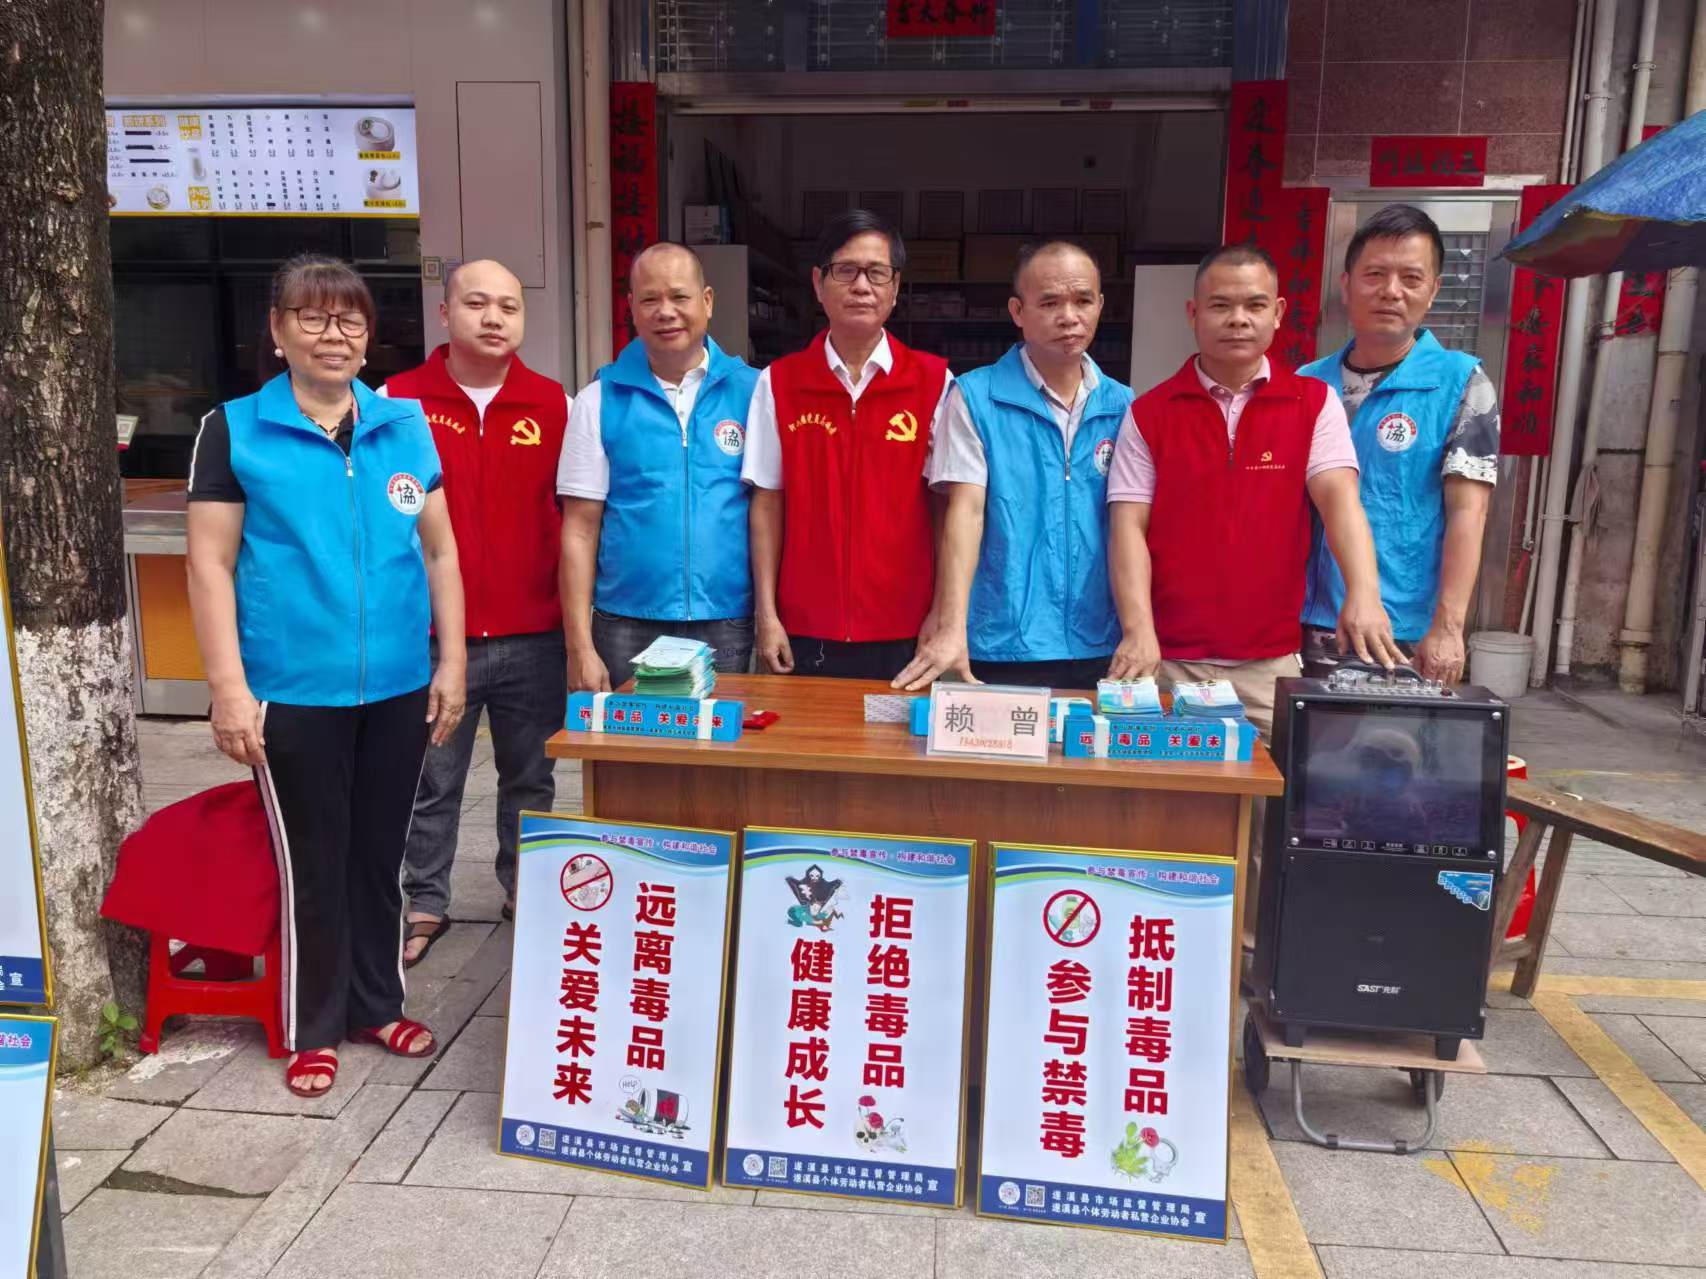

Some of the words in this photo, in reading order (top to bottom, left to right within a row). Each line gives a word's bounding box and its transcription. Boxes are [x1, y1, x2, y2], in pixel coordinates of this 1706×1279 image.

[552, 920, 602, 1106] 关爱未来
[626, 881, 677, 1071] 远离毒品
[783, 937, 835, 1130] 健康成长
[862, 894, 914, 1089] 拒绝毒品
[1040, 958, 1092, 1160] 参与禁毒
[1124, 914, 1176, 1116] 抵制毒品
